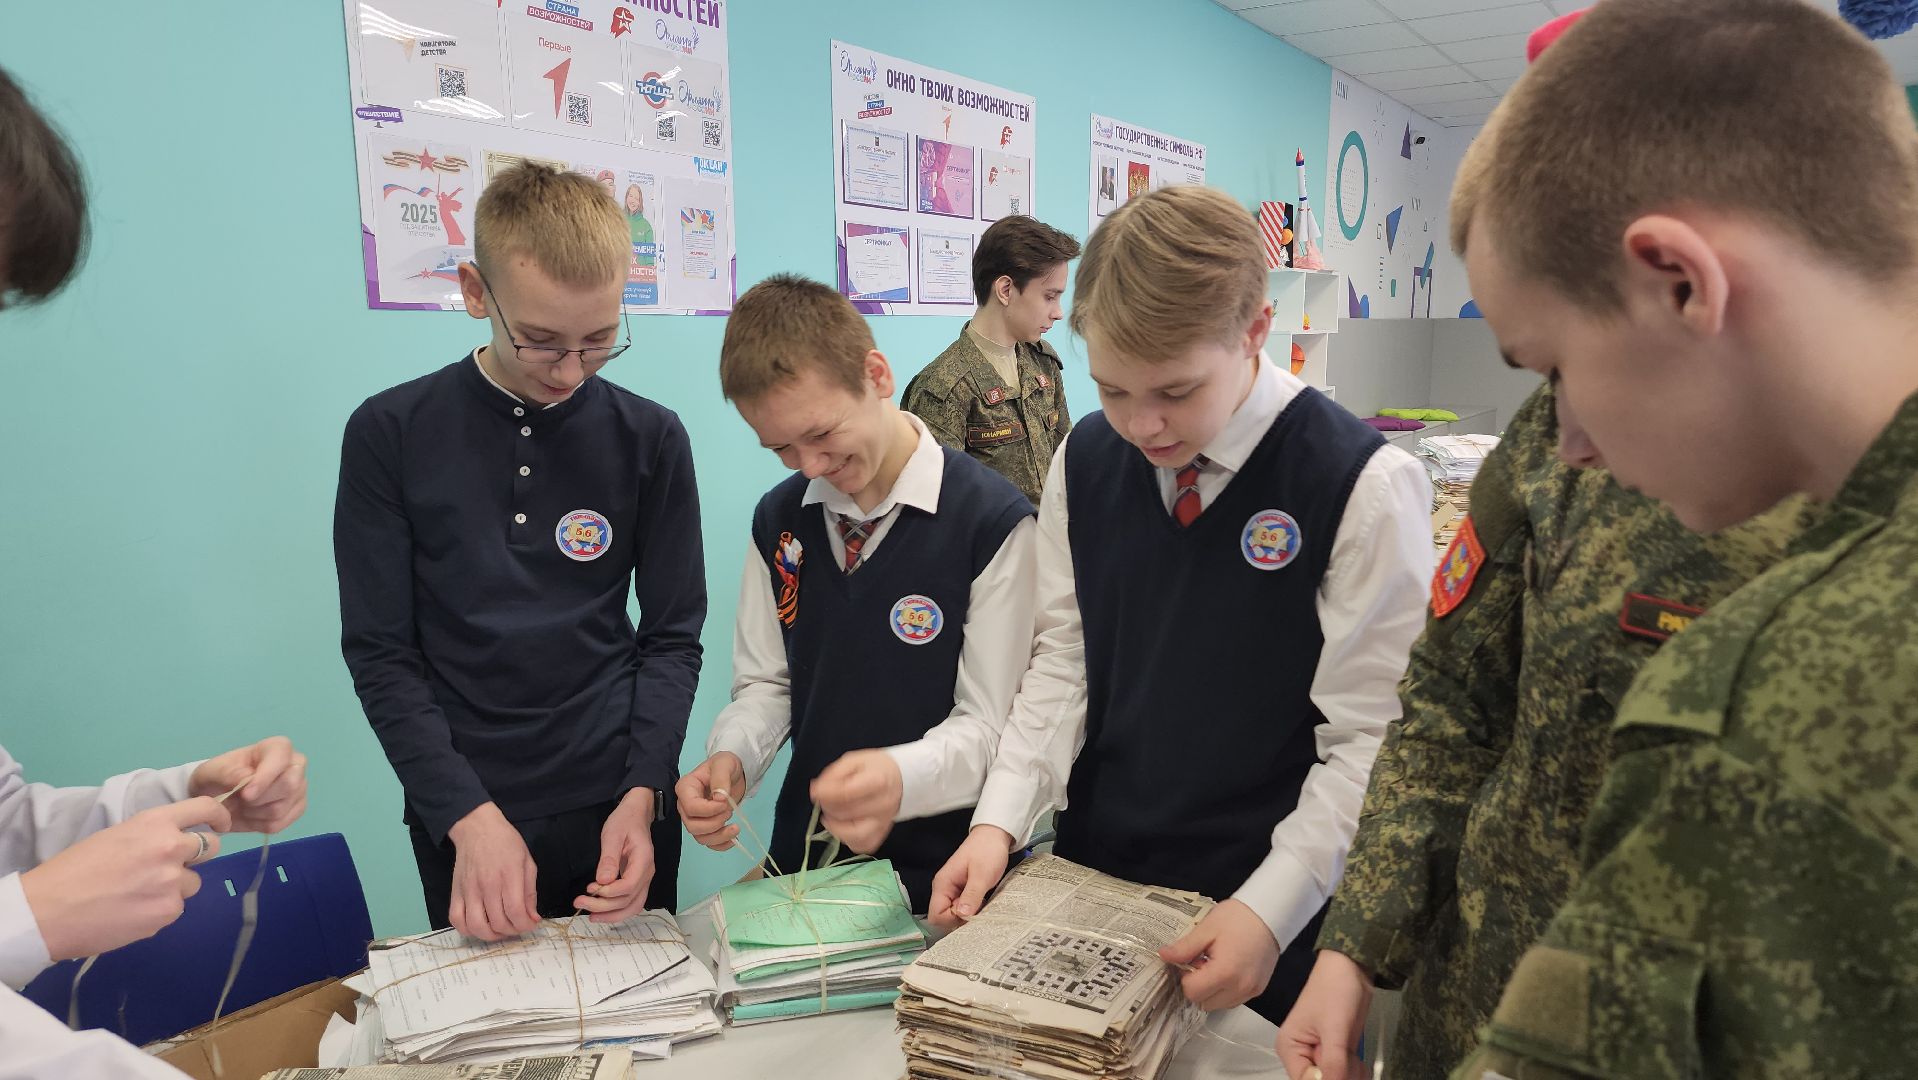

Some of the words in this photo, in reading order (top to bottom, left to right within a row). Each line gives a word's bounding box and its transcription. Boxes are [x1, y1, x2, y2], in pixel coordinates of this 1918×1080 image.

[528, 7, 591, 30] ВОЗМОЖНОСТЕЙ
[547, 1, 577, 15] СТРАНА
[420, 48, 447, 56] ДЕТСТВА
[538, 36, 572, 53] Первые
[886, 68, 916, 94] ОКНО
[919, 77, 954, 103] ТВОИХ
[957, 88, 1030, 123] ВОЗМОЖНОСТЕЙ
[1115, 125, 1169, 151] ГОСУДАРСТВЕННЫЕ
[1169, 140, 1194, 158] СИМВОЛЫ
[400, 202, 438, 224] 2025
